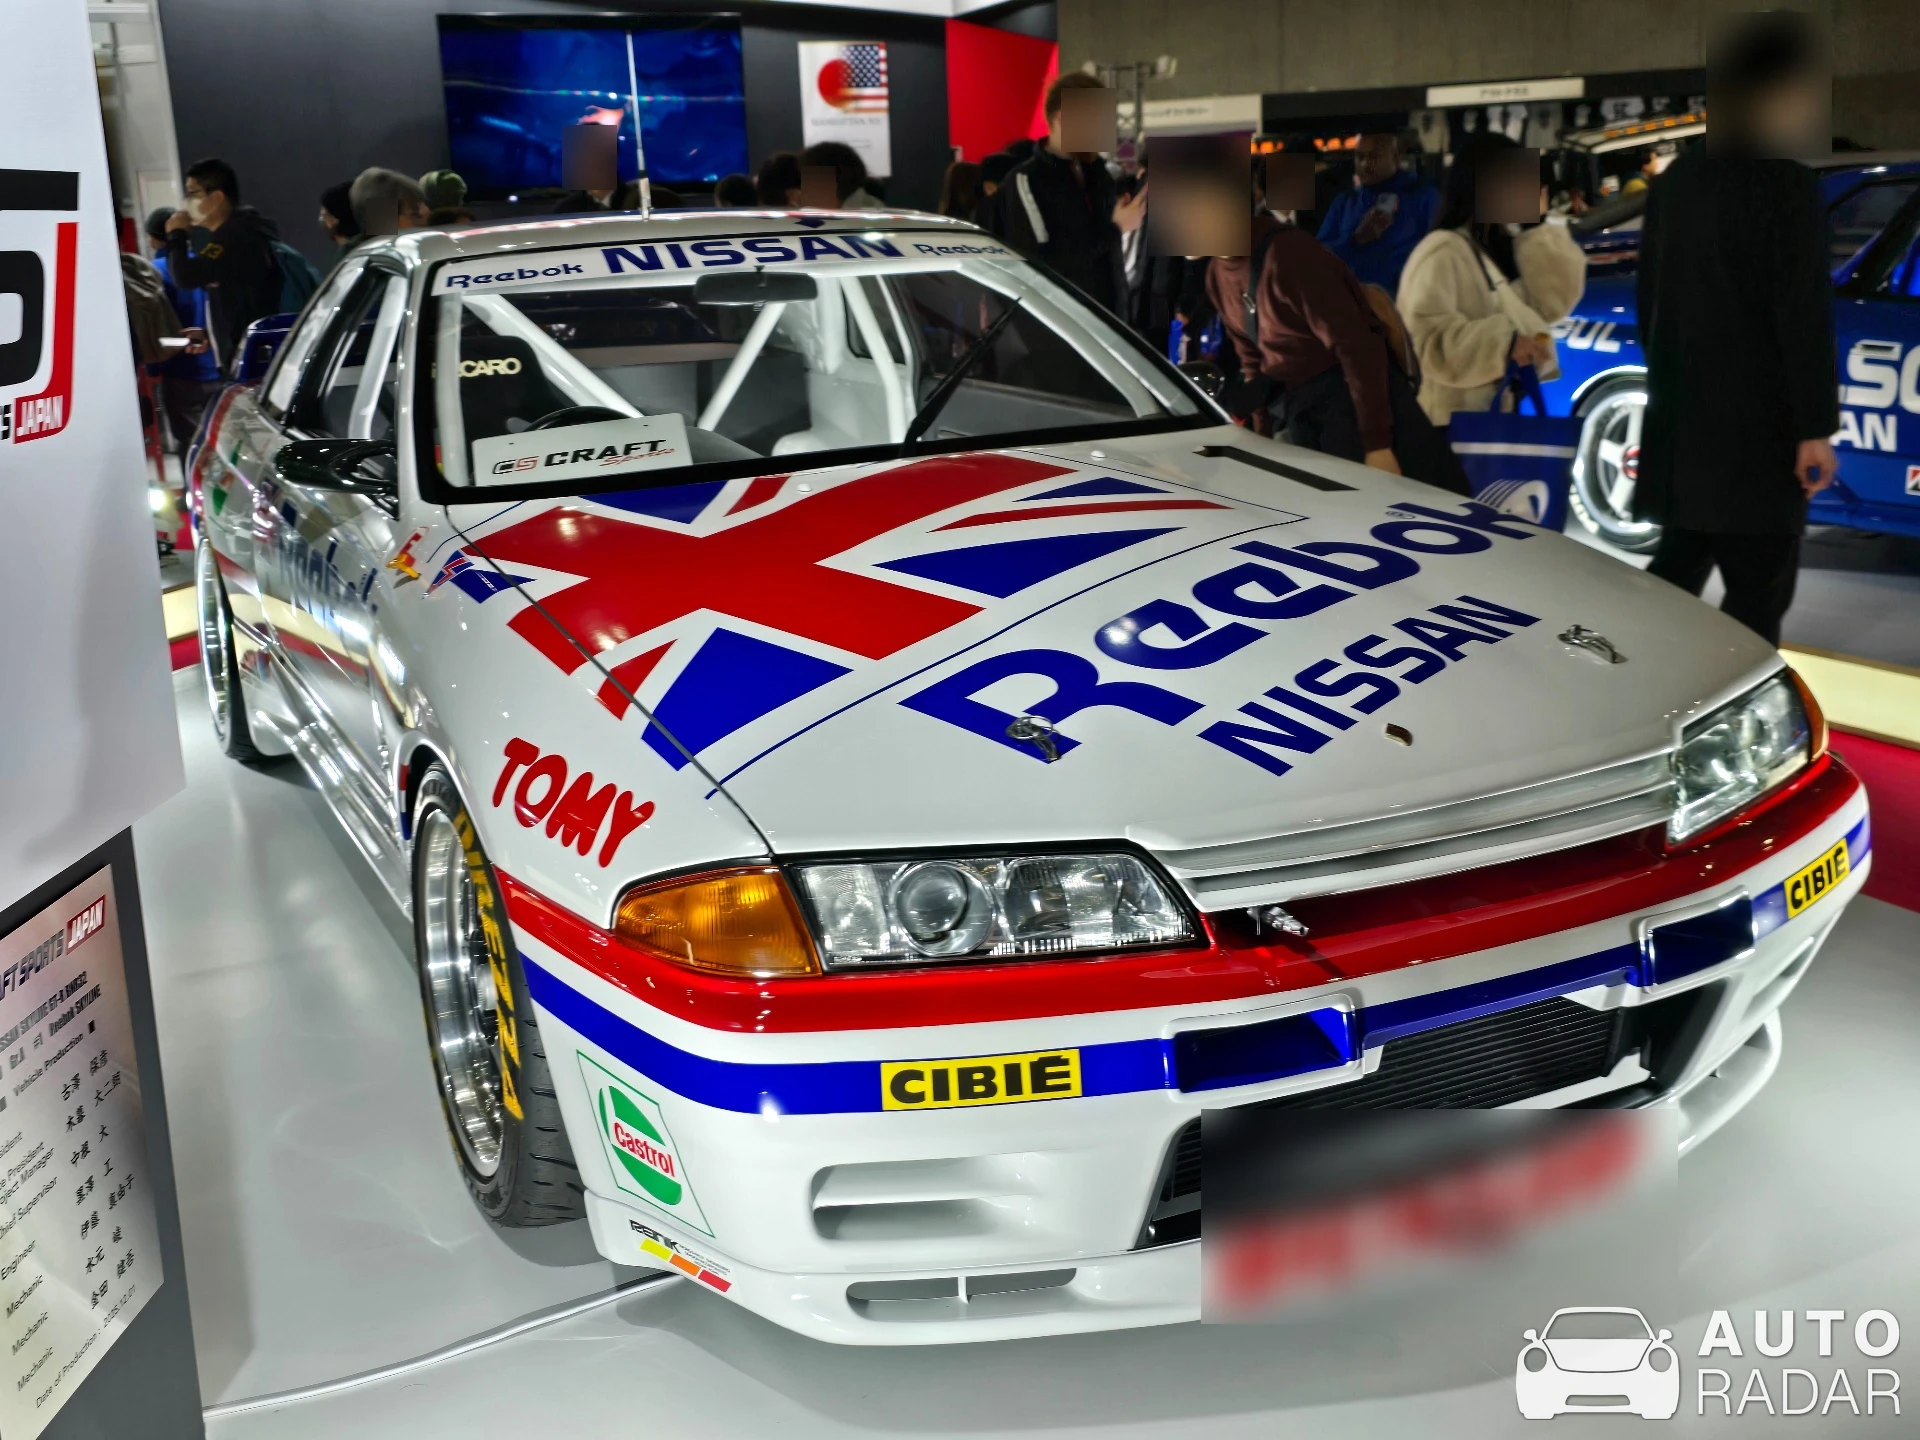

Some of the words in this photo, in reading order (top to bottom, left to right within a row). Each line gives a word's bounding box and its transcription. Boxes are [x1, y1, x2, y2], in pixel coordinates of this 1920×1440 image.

[444, 262, 585, 289] Reebok
[602, 234, 905, 275] NISSAN
[914, 242, 1011, 258] Reebok
[16, 395, 63, 437] JAPAN
[492, 456, 540, 475] CS
[544, 439, 667, 467] CRAFT
[898, 501, 1537, 764] Reebok
[1197, 595, 1541, 777] NISSAN
[492, 736, 656, 868] TOMY
[19, 929, 64, 985] SPORTS
[68, 900, 103, 948] JAPAN
[75, 984, 101, 1015] SKYLINE
[14, 1068, 44, 1097] Vehicle
[44, 1033, 84, 1071] Production
[98, 1124, 110, 1143] 大
[613, 1121, 675, 1178] Castrol
[8, 1142, 44, 1180] President
[20, 1147, 54, 1183] Manager
[18, 1177, 58, 1220] Supervisor
[0, 1240, 36, 1281] Engineer
[6, 1275, 43, 1318] Mechanic
[12, 1311, 48, 1355] Mechanic
[17, 1346, 54, 1392] Mechanic
[36, 1385, 53, 1409] Date
[54, 1370, 62, 1387] of
